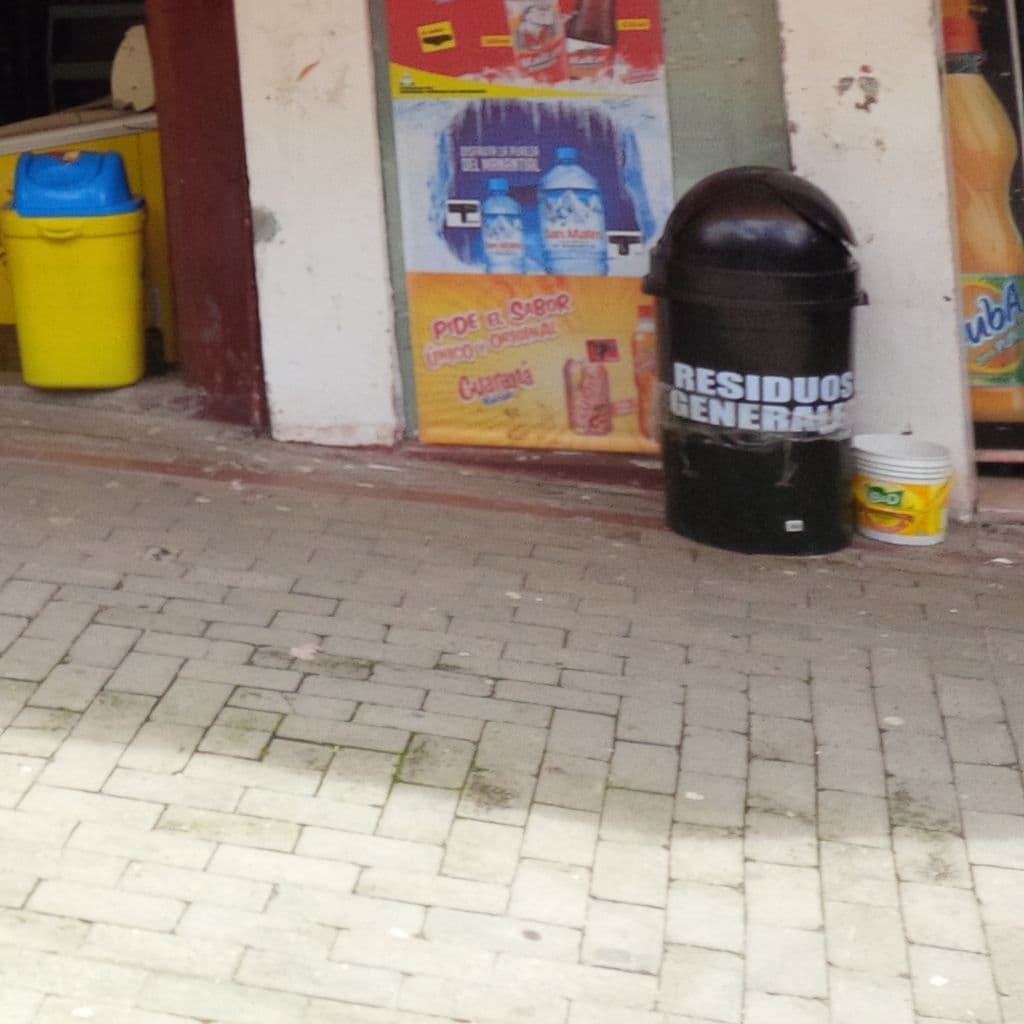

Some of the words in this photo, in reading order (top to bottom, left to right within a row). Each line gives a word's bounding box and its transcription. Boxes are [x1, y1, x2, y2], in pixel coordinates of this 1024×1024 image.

[432, 313, 477, 340] PIDE
[510, 294, 571, 322] SABOR
[673, 362, 854, 403] RESIDUOS
